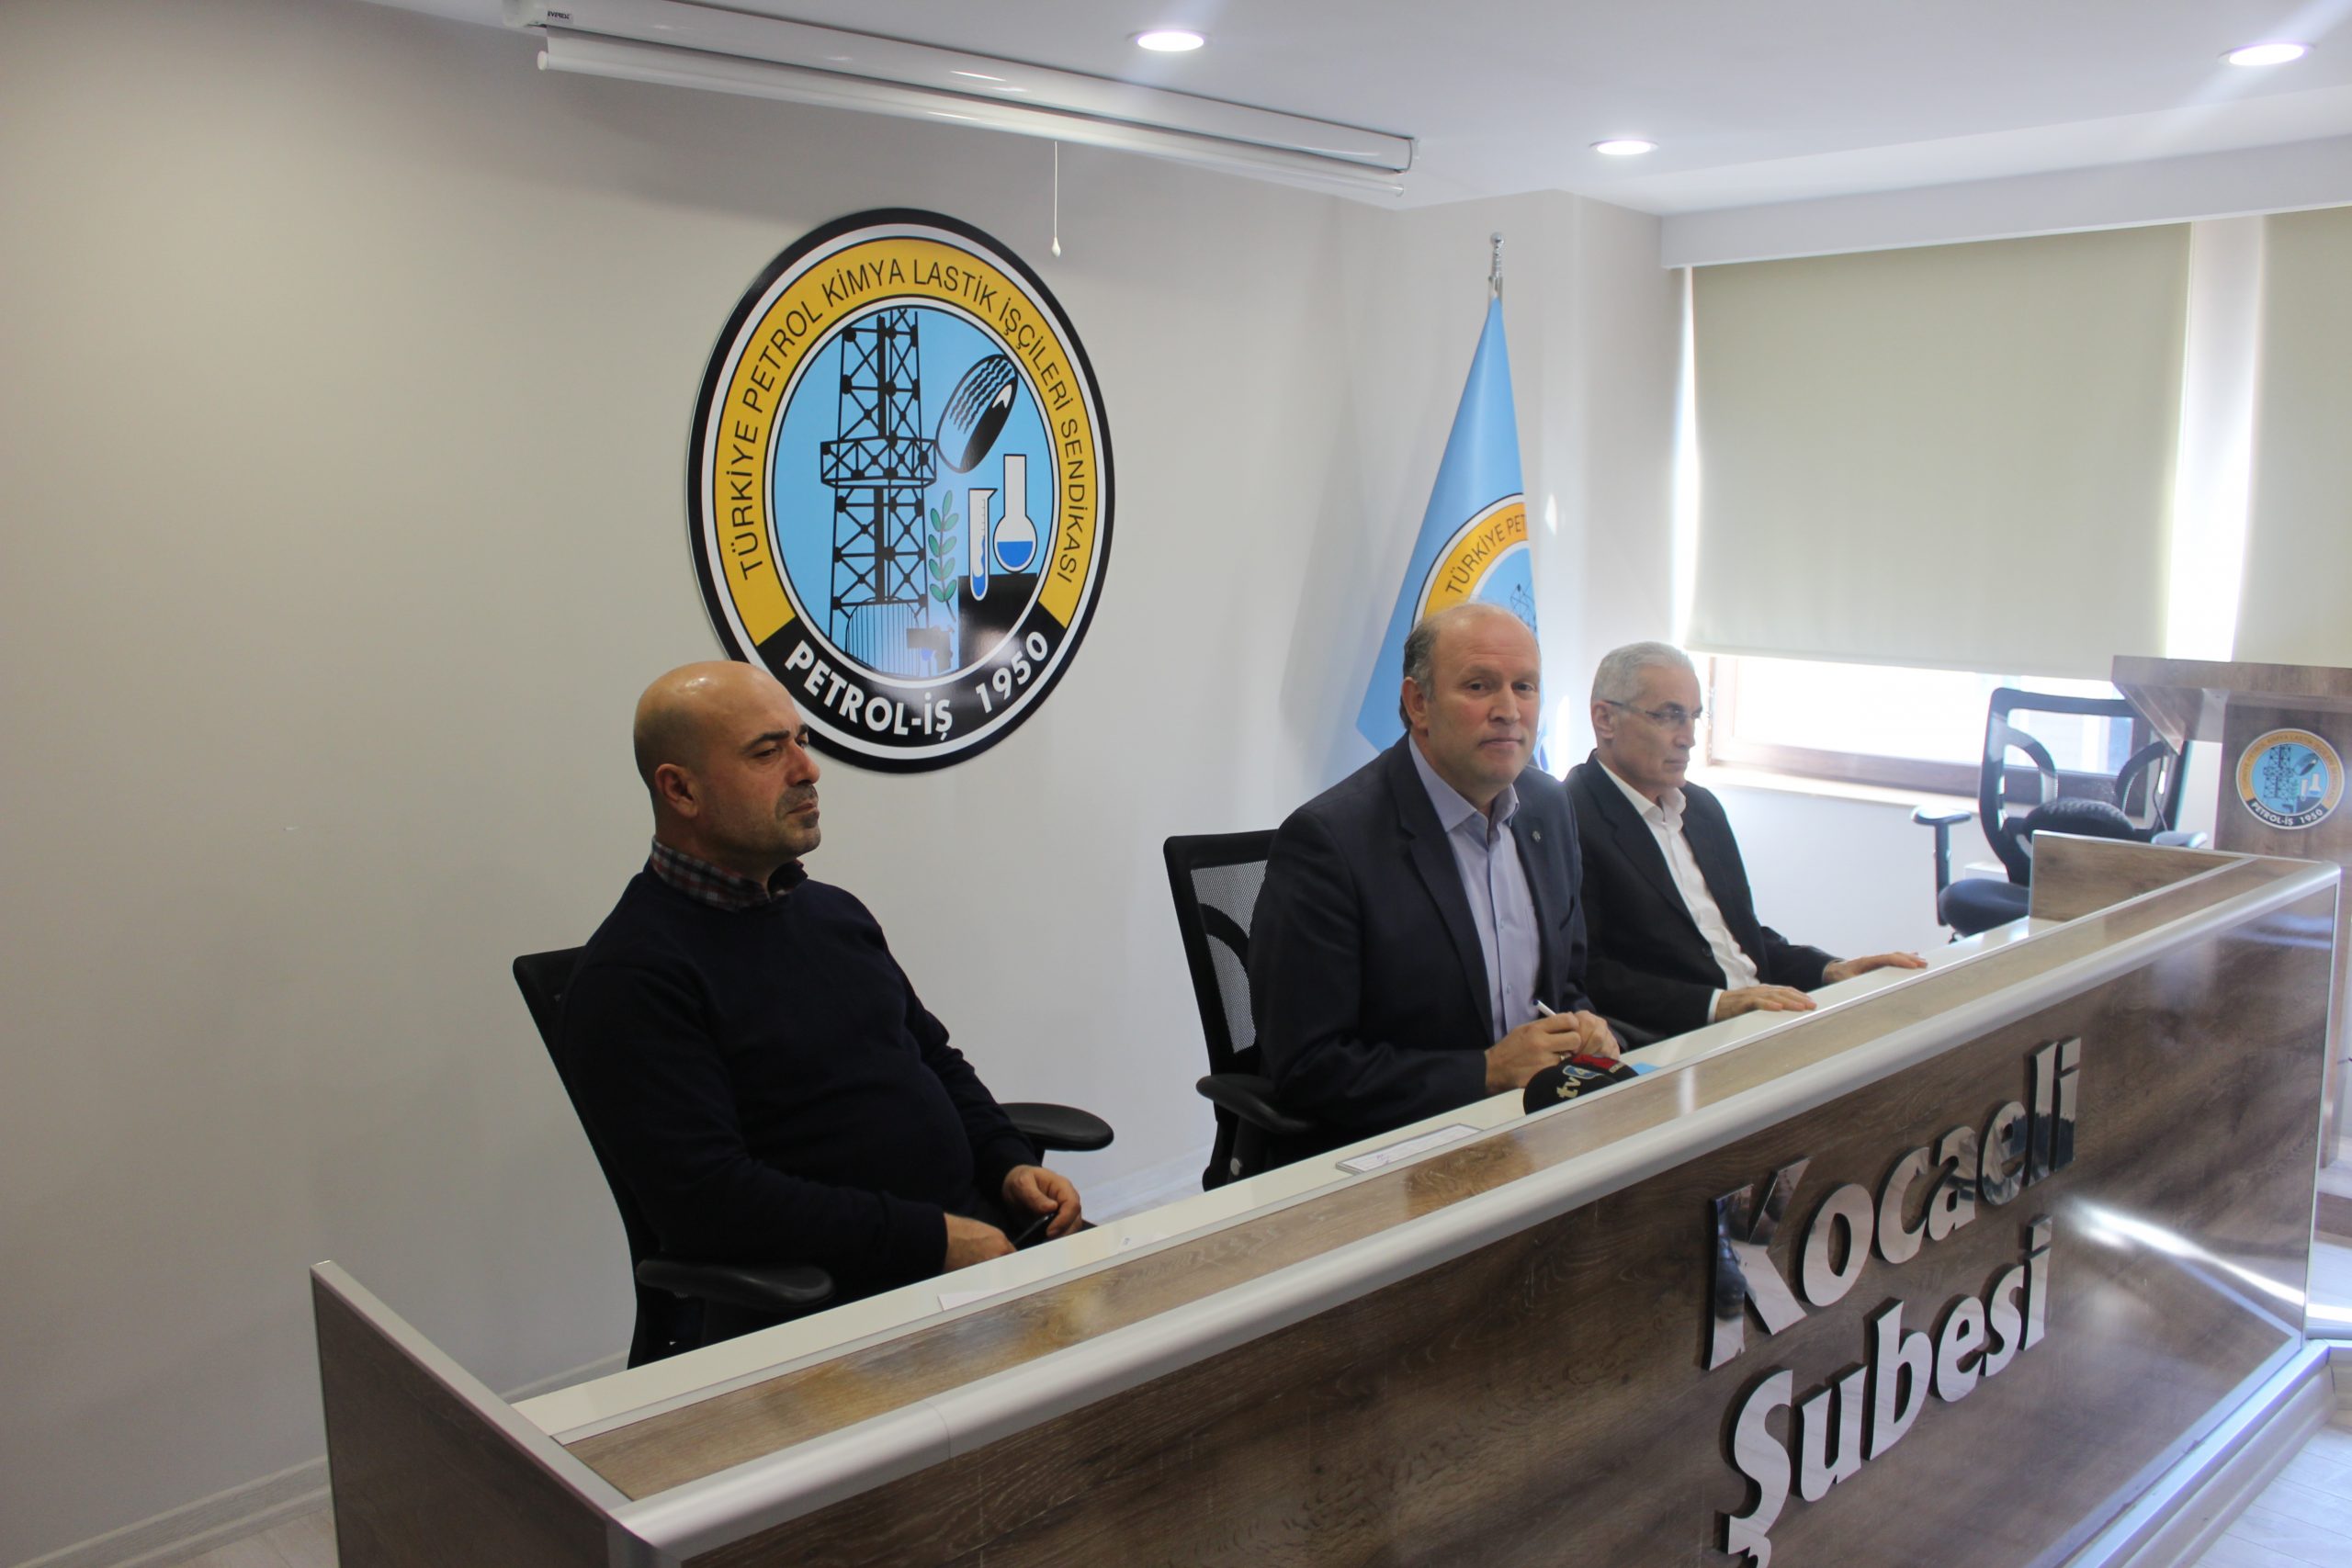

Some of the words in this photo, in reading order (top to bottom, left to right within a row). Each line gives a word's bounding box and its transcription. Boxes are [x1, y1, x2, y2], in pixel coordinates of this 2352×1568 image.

[821, 257, 906, 308] KİMYA
[913, 259, 999, 312] LASTİK
[743, 299, 823, 414] PETROL
[999, 297, 1073, 411] İŞÇİLERİ
[725, 420, 763, 581] TÜRKİYE
[1057, 418, 1088, 583] SENDİKASI
[1444, 523, 1506, 594] TÜRKİYE
[784, 639, 954, 740] PETROL-İŞ
[976, 630, 1049, 716] 1950
[2300, 809, 2324, 824] 1950
[1704, 1036, 2082, 1371] Kocaeli
[1720, 1213, 2052, 1568] Şubesi
